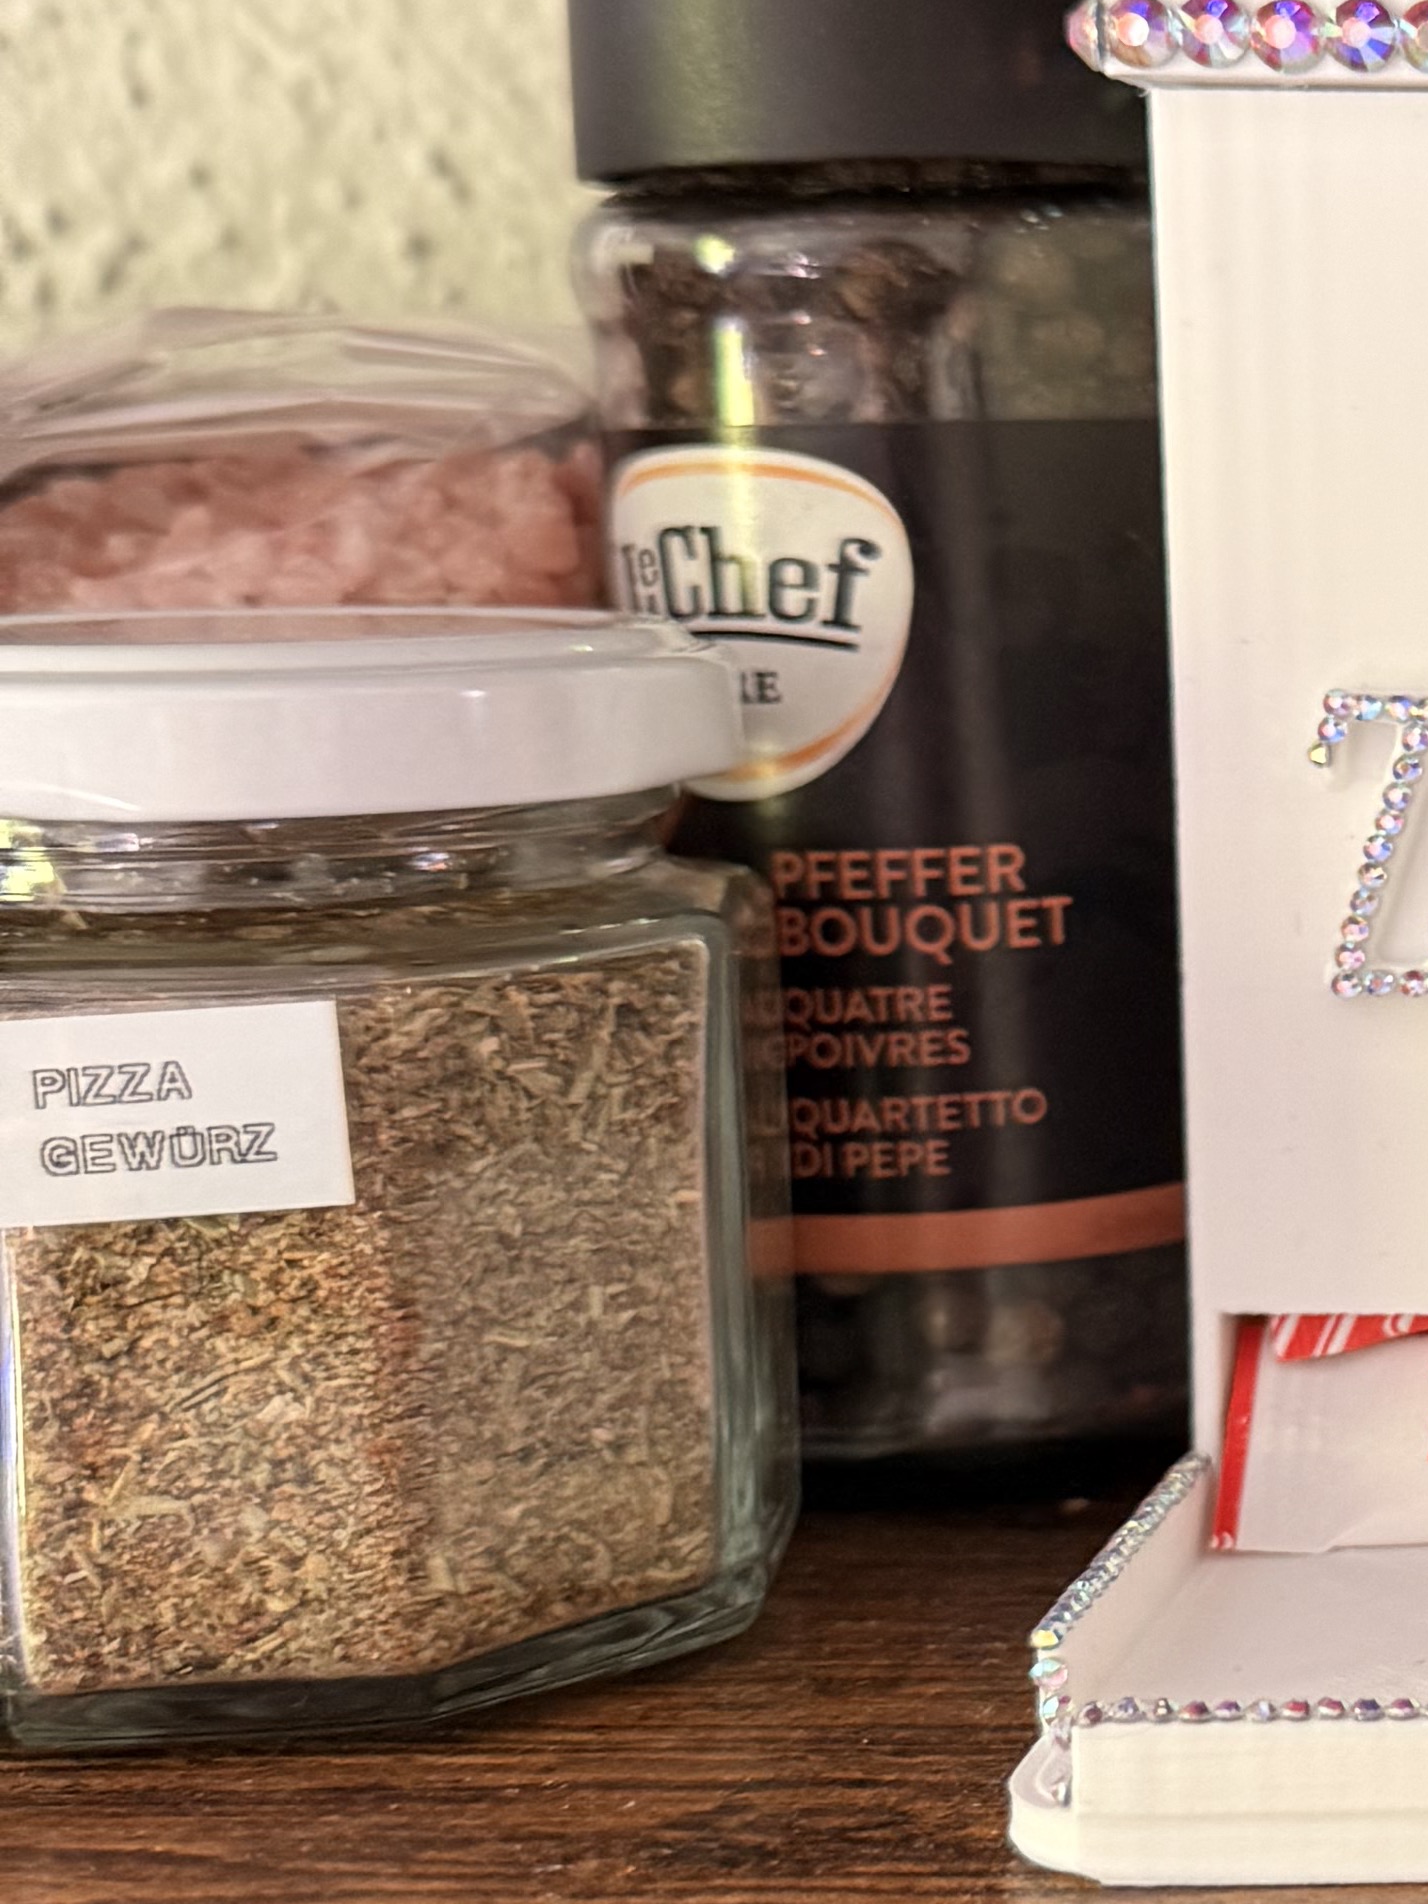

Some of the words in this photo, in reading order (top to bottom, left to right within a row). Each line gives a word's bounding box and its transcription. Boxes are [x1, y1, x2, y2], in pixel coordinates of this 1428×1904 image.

[771, 842, 1027, 899] PFEFFER
[776, 895, 1075, 965] BOUQUET
[783, 983, 955, 1031] QUATRE
[784, 1028, 973, 1070] POIVRES
[32, 1060, 193, 1110] PIZZA
[791, 1086, 1050, 1141] QUARTETTO
[40, 1122, 278, 1177] GEWÜRZ
[793, 1141, 835, 1180] DI
[841, 1139, 954, 1180] PEPE
